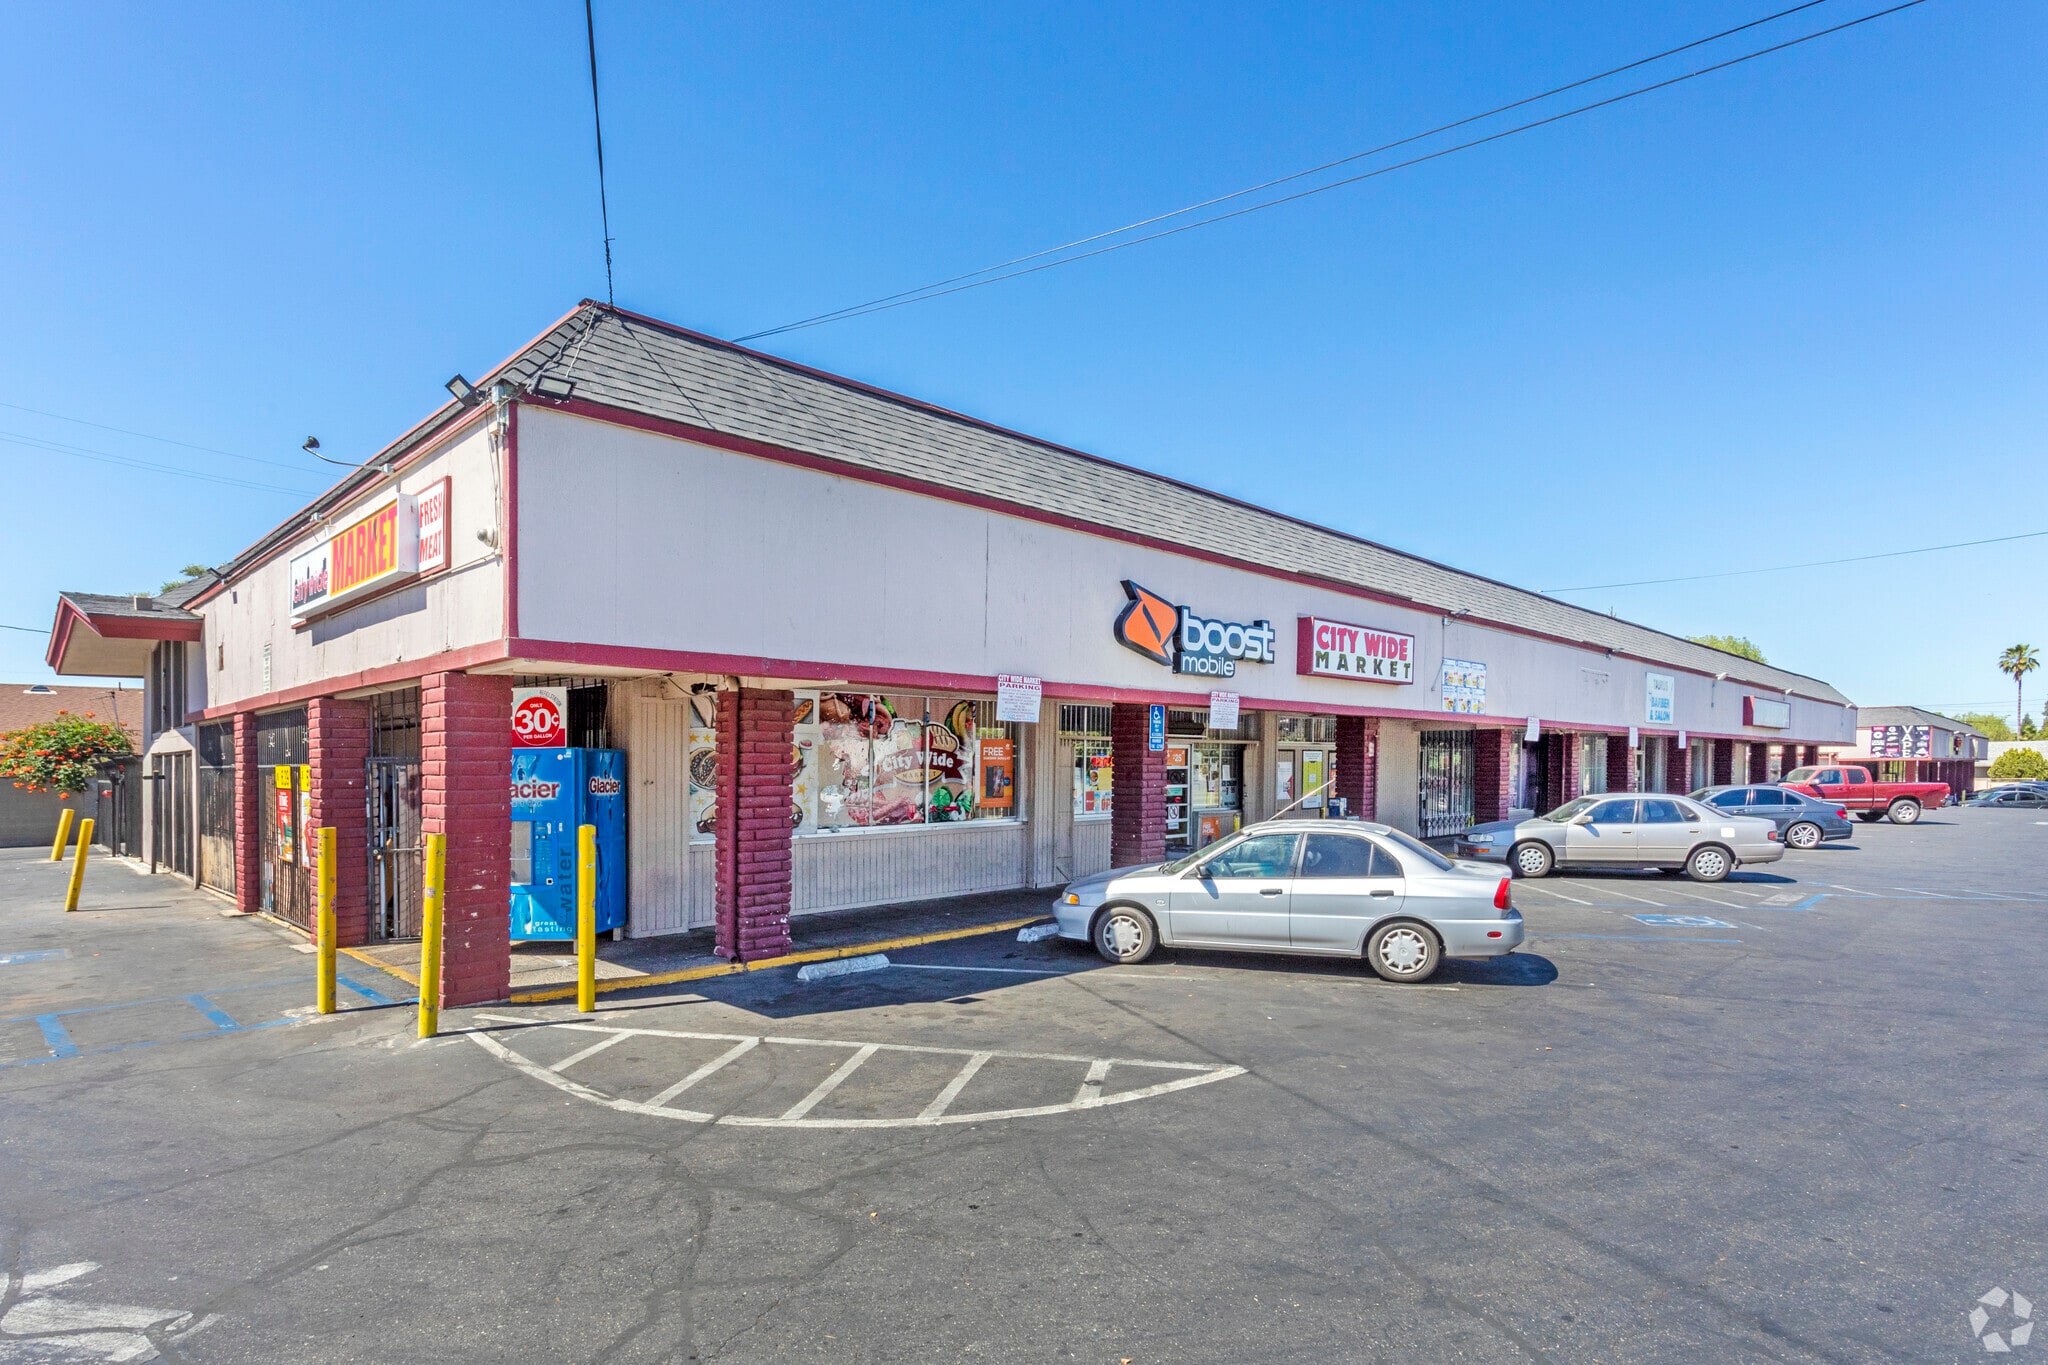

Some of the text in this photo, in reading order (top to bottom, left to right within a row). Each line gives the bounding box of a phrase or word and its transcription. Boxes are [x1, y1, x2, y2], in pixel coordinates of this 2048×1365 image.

[419, 492, 443, 528] FRESH
[331, 505, 398, 594] MARKET
[419, 530, 442, 563] MEAT
[1183, 609, 1274, 661] boost
[1316, 625, 1409, 661] CITY WIDE
[1182, 655, 1235, 676] mobile
[1315, 651, 1411, 679] MARKET
[515, 708, 560, 734] 30¢
[983, 746, 1004, 757] FREE
[1901, 725, 1914, 758] VAPE
[882, 751, 954, 772] City Wide
[589, 777, 621, 794] Glacier
[558, 848, 573, 912] water
